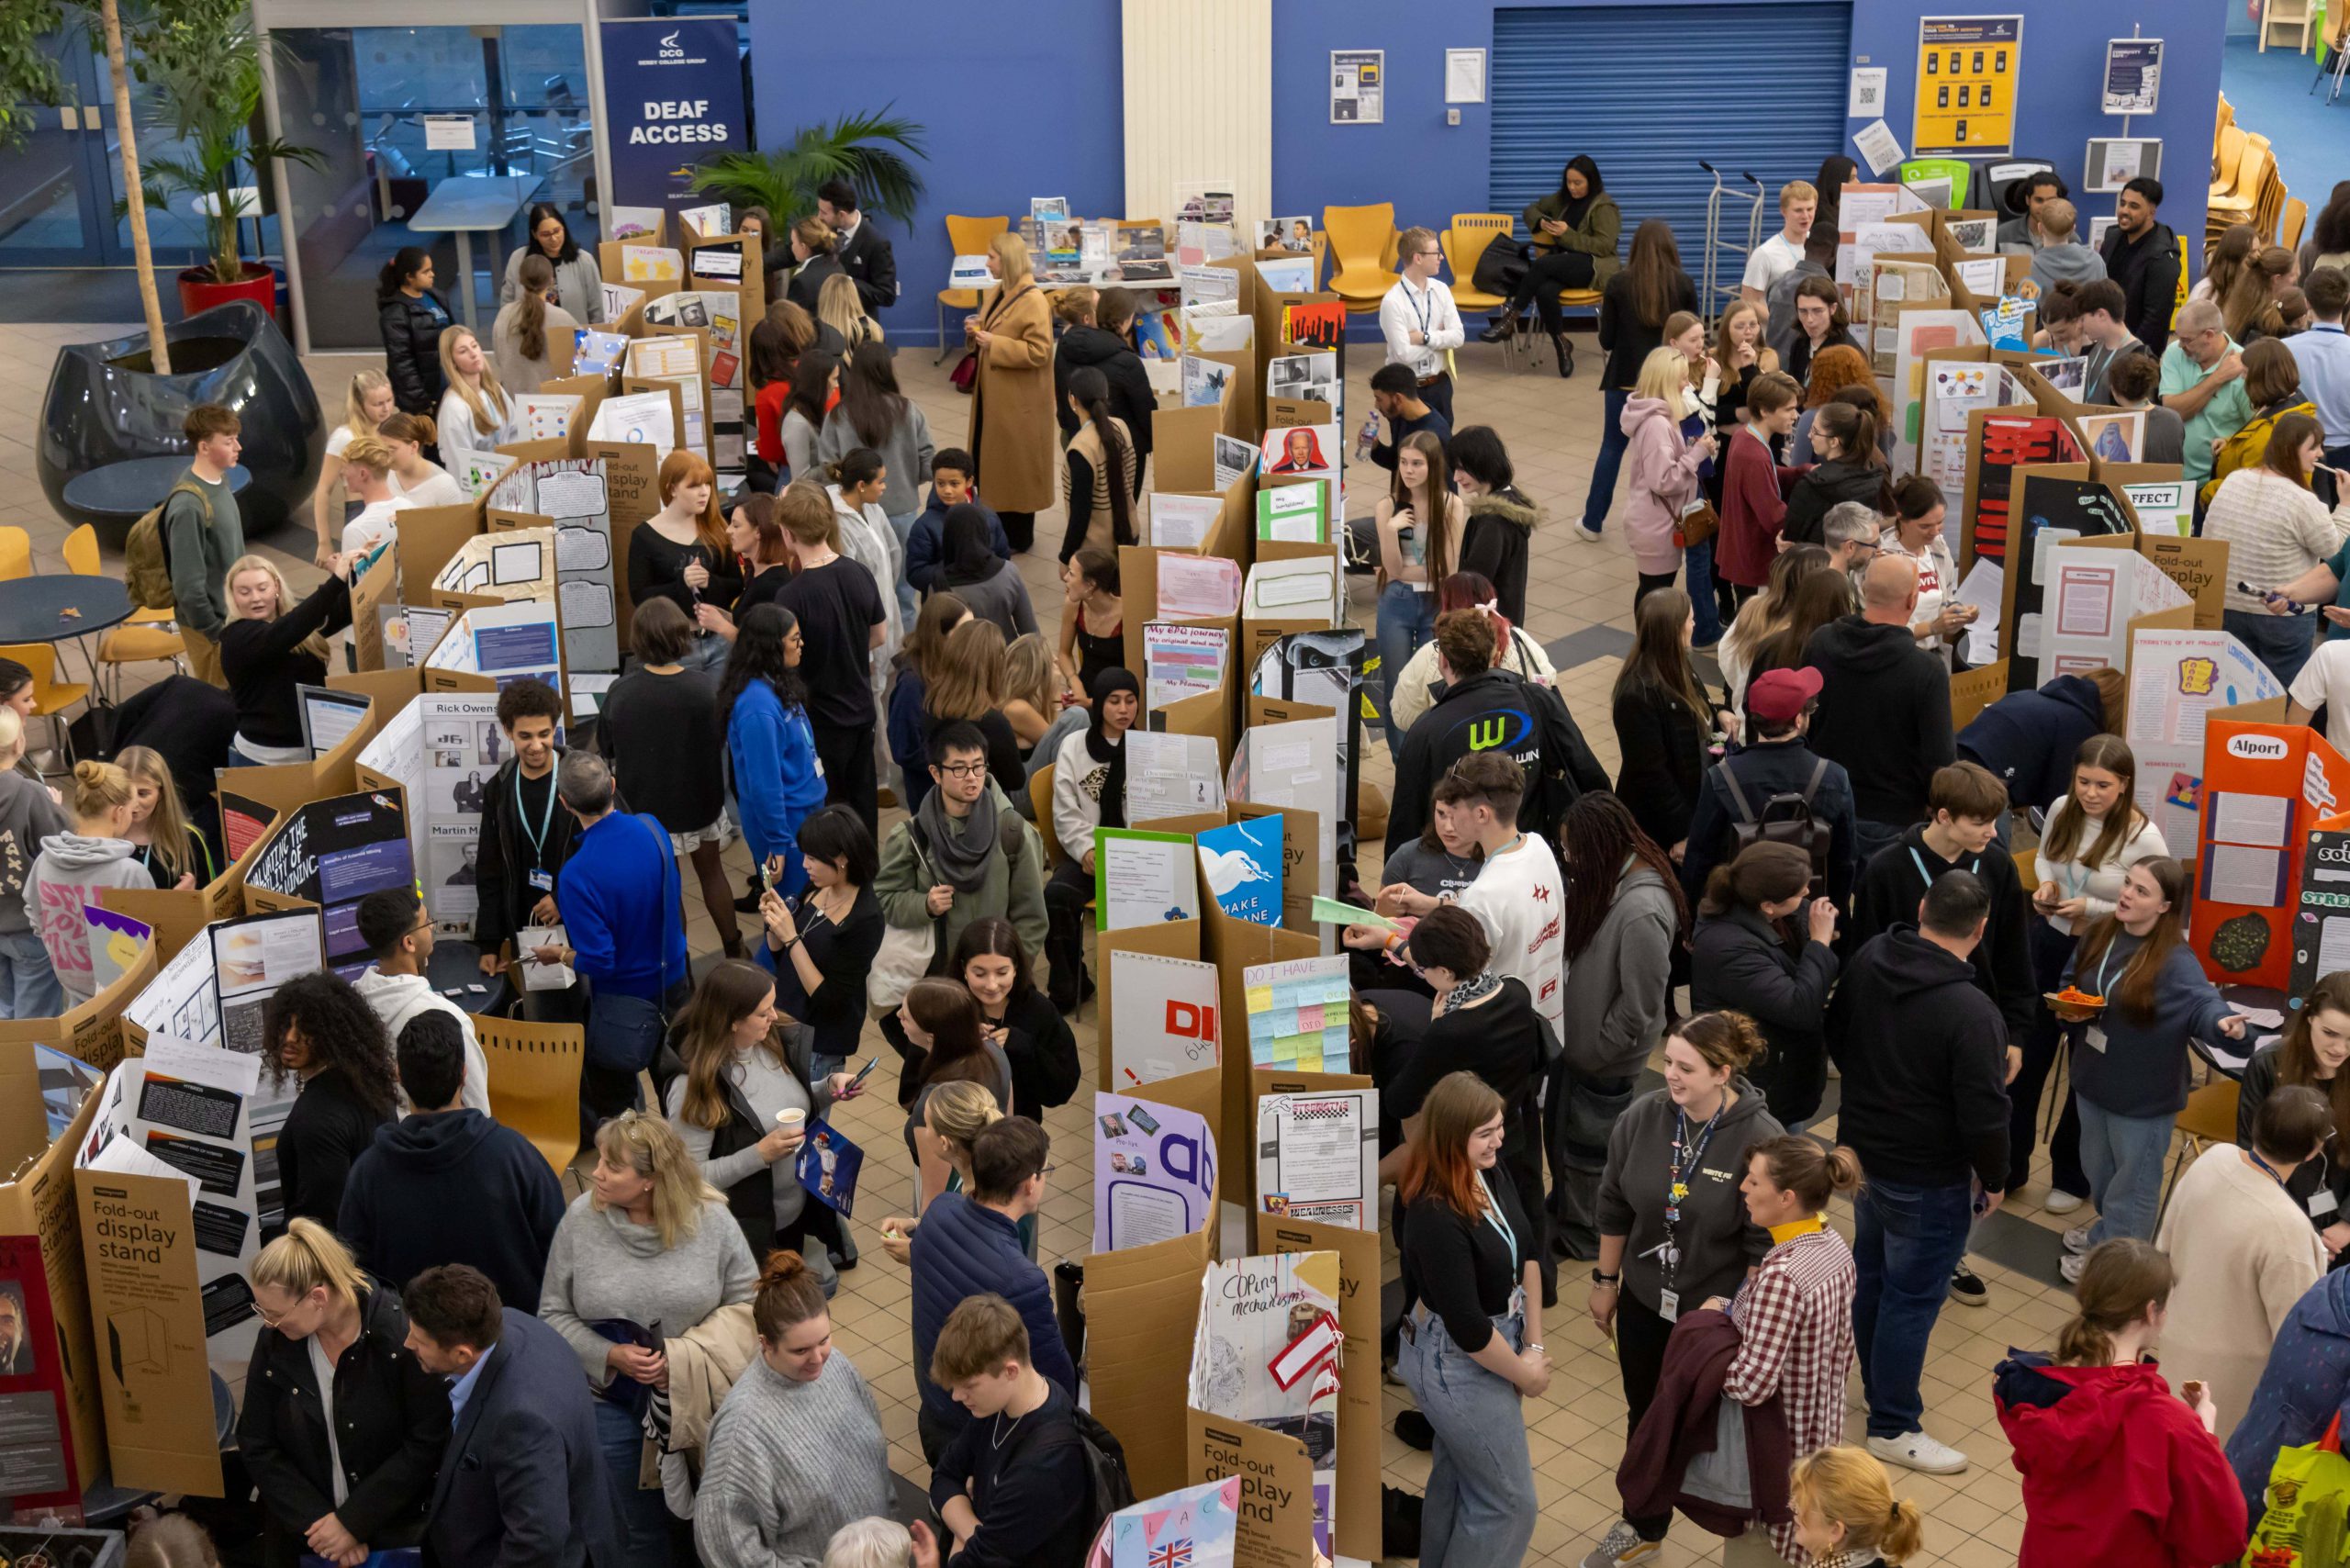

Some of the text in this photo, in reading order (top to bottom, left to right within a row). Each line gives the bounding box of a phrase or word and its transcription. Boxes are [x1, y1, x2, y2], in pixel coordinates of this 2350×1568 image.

[659, 49, 684, 57] DCG
[644, 100, 709, 120] DEAF
[630, 123, 728, 144] ACCESS
[607, 473, 648, 488] isplay
[608, 487, 640, 499] tand
[1147, 625, 1164, 634] My
[1190, 629, 1224, 639] journey
[437, 704, 499, 713] Rick Owens
[1516, 748, 1539, 764] WIN
[2233, 739, 2281, 755] Alport
[289, 815, 308, 847] THE
[432, 826, 466, 835] Martin
[291, 844, 302, 868] OF
[2302, 891, 2350, 906] STRE
[1246, 968, 1265, 986] DO
[1269, 966, 1277, 980] I
[1282, 959, 1316, 976] HAVE
[74, 1017, 116, 1052] Fold-out
[94, 1201, 161, 1222] Fold-out
[96, 1218, 176, 1249] display
[99, 1242, 162, 1264] stand
[1232, 1289, 1305, 1316] mechanisms
[1204, 1443, 1276, 1477] Fold-out
